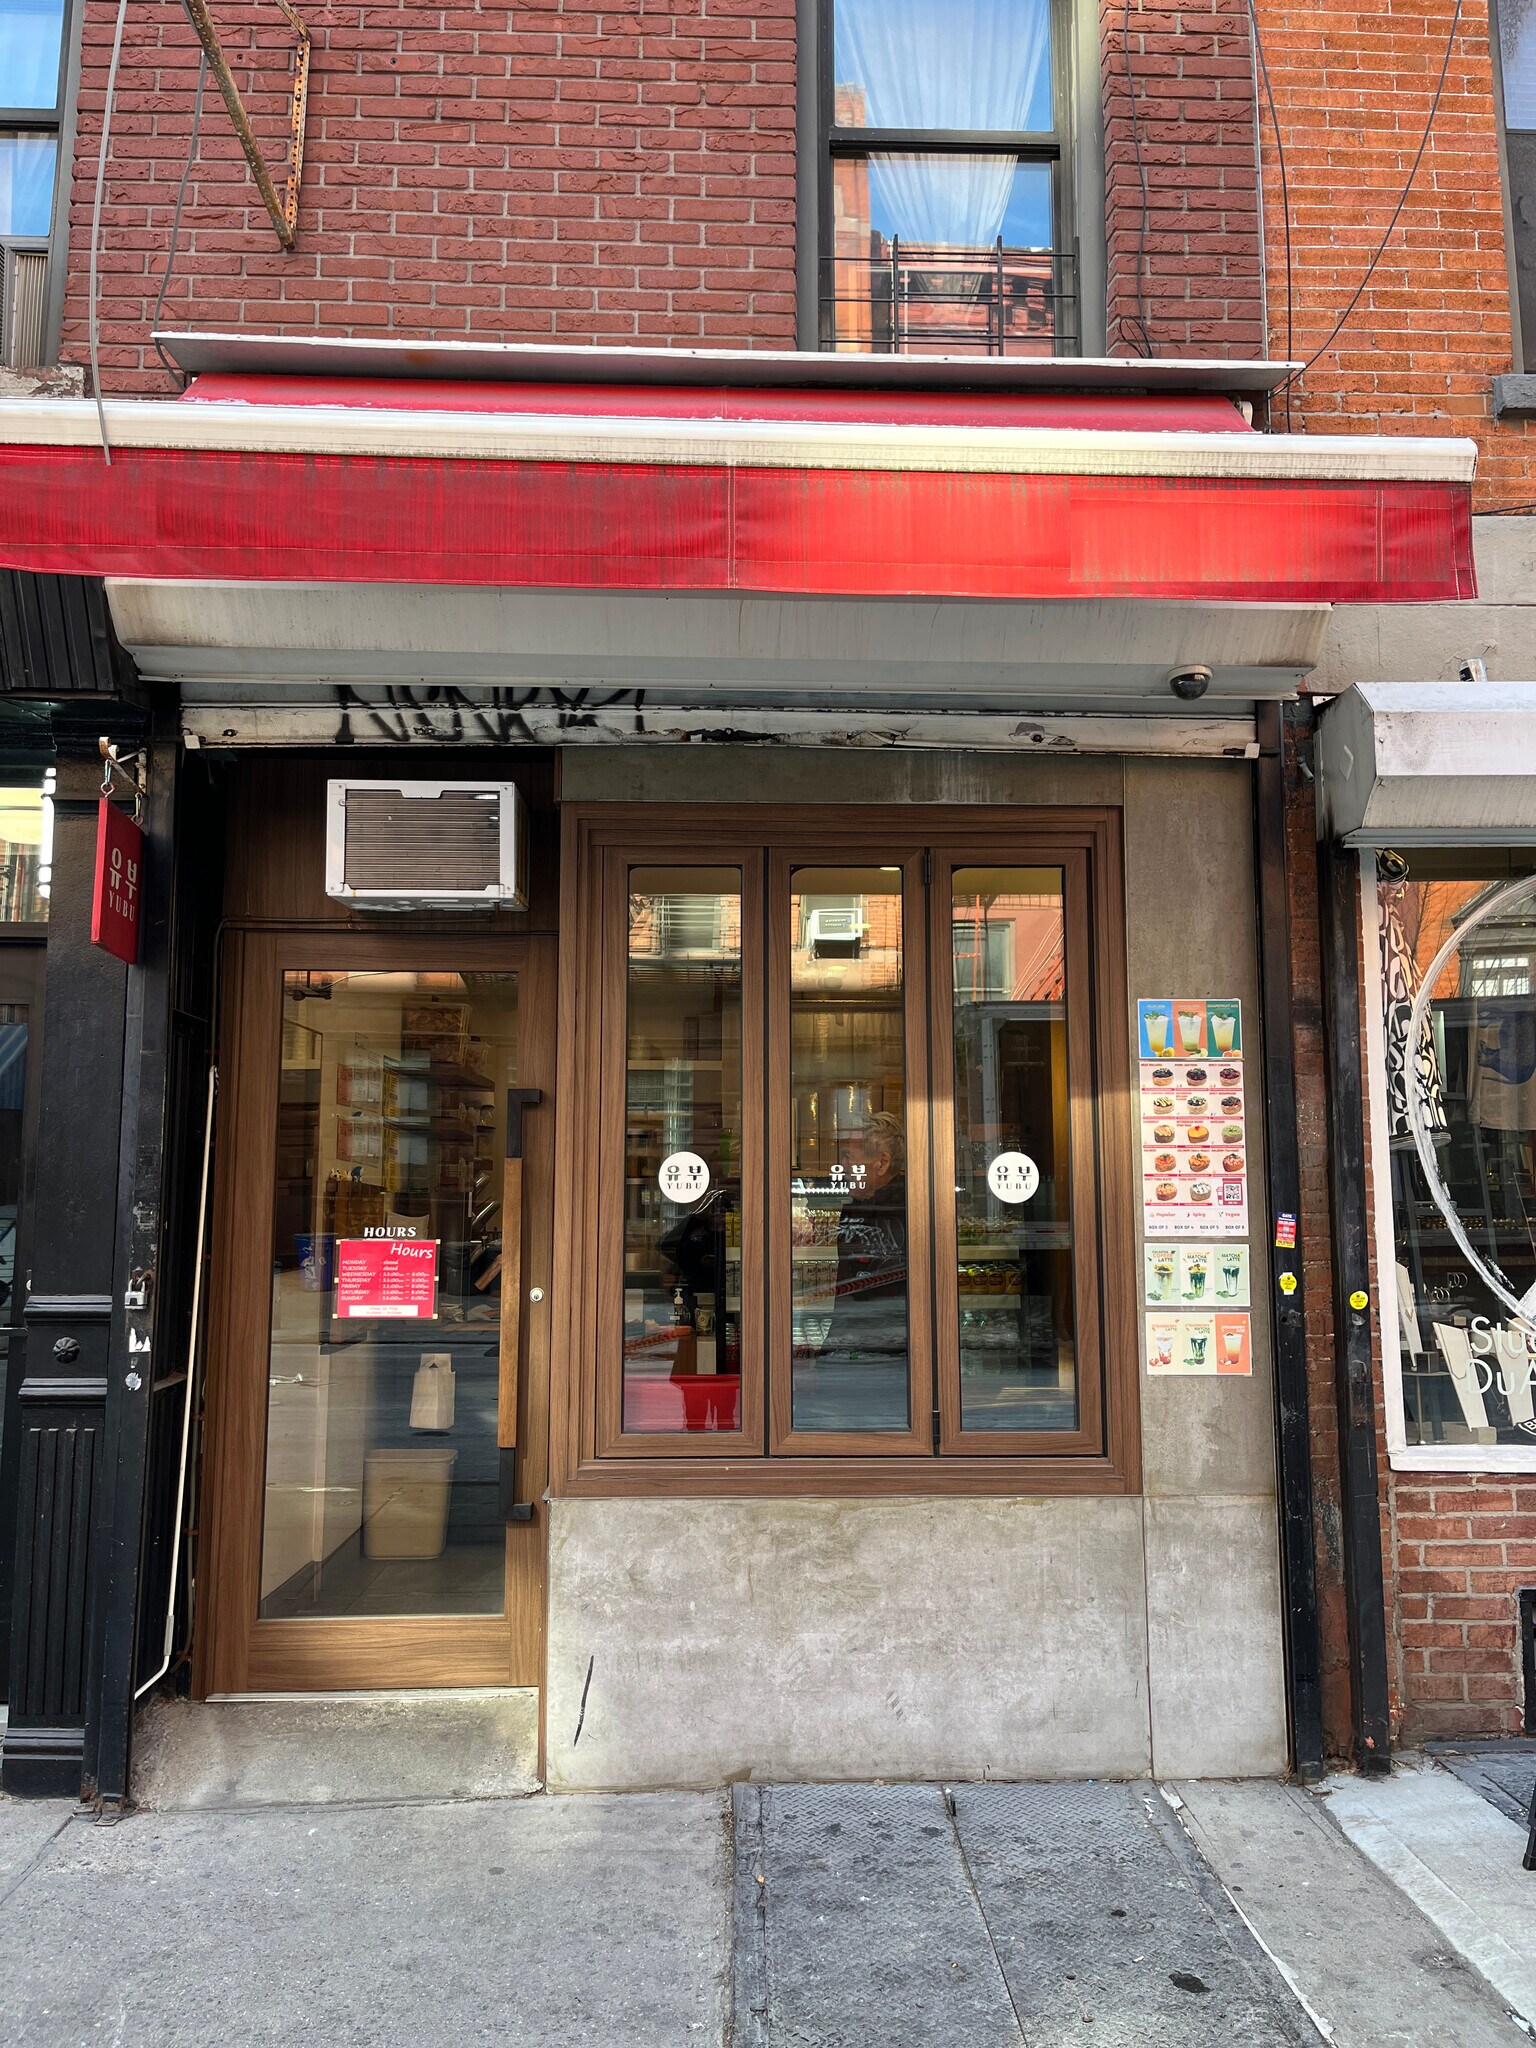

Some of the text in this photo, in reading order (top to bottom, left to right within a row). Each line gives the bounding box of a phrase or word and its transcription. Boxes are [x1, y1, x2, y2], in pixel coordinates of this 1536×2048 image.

[109, 847, 137, 900] 유부
[108, 889, 136, 922] YUBU
[364, 1227, 416, 1237] HOURS
[390, 1243, 433, 1259] Hours
